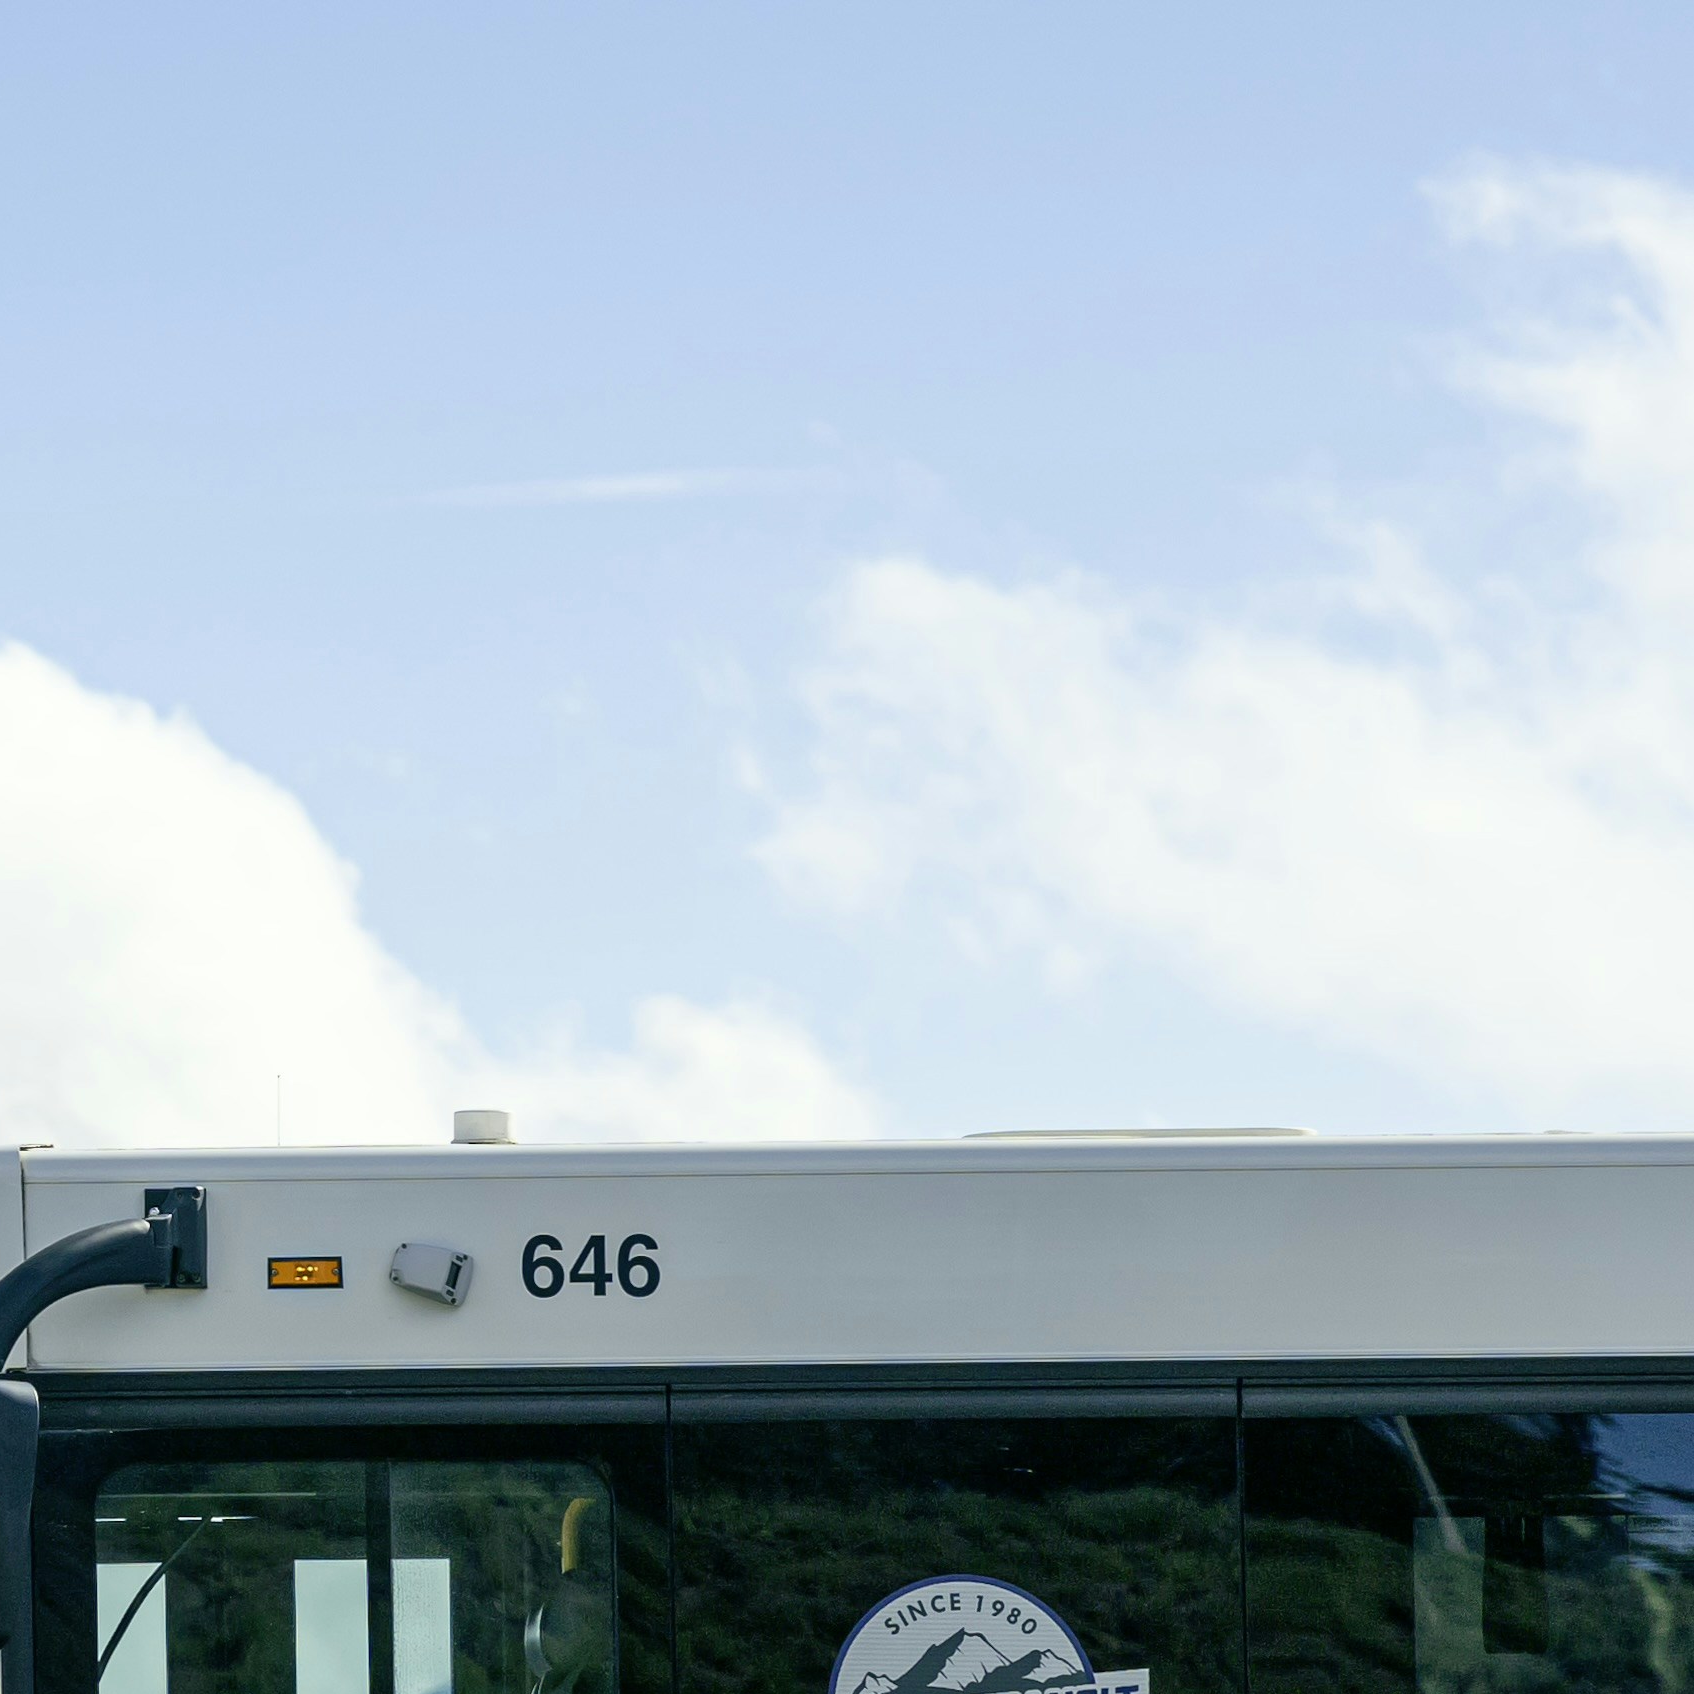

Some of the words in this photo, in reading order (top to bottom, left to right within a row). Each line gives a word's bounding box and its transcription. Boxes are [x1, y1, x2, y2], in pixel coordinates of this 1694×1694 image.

[521, 1233, 661, 1299] 646
[884, 1592, 962, 1636] SINCE
[975, 1594, 1038, 1635] 1980
